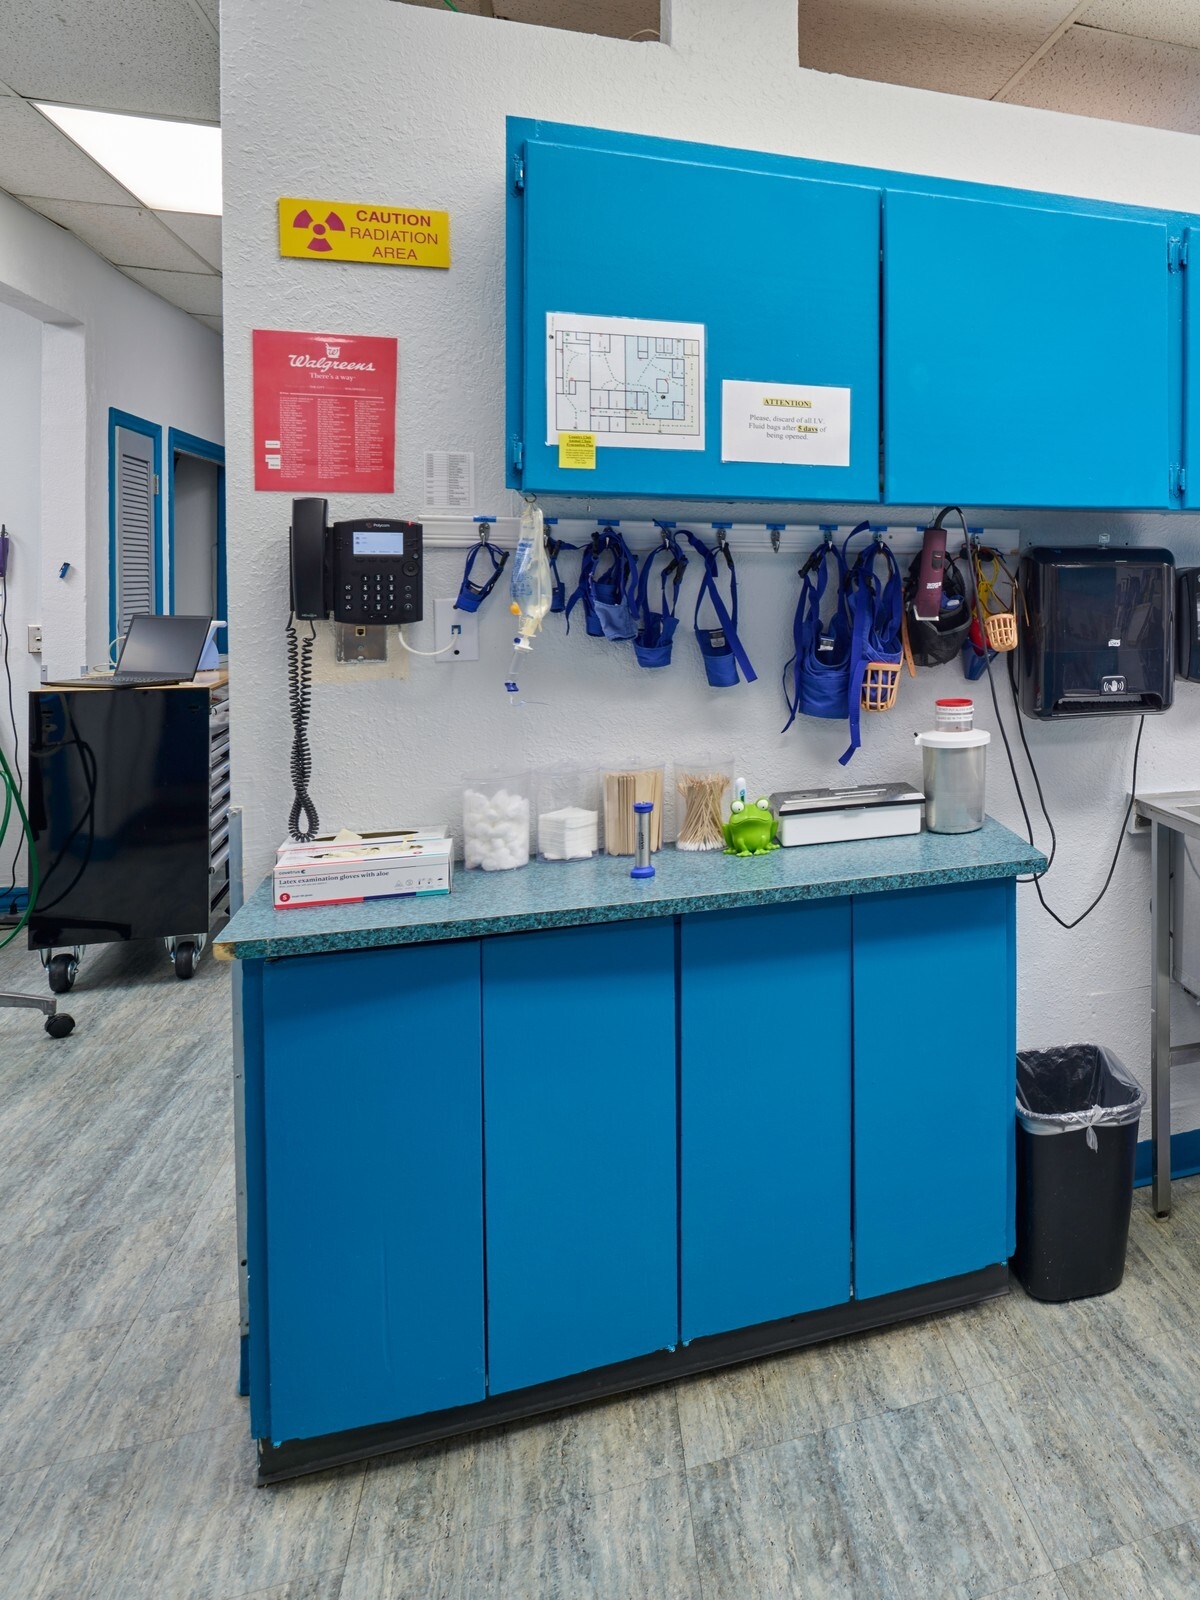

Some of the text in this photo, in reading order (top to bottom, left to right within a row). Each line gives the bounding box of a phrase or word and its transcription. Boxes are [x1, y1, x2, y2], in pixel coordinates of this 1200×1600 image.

[356, 209, 432, 227] CAUTION
[350, 227, 438, 245] RADIATION
[372, 246, 418, 260] AREA
[288, 354, 376, 373] Walgreens
[309, 372, 334, 380] There's
[763, 398, 812, 408] ATTENTION:
[749, 414, 772, 422] Please,
[772, 415, 795, 423] discard
[748, 422, 765, 430] Fluid
[766, 423, 781, 431] bags
[782, 423, 796, 431] after
[803, 425, 818, 433] days
[766, 432, 784, 440] being
[298, 876, 339, 884] examination
[340, 873, 360, 881] gloves
